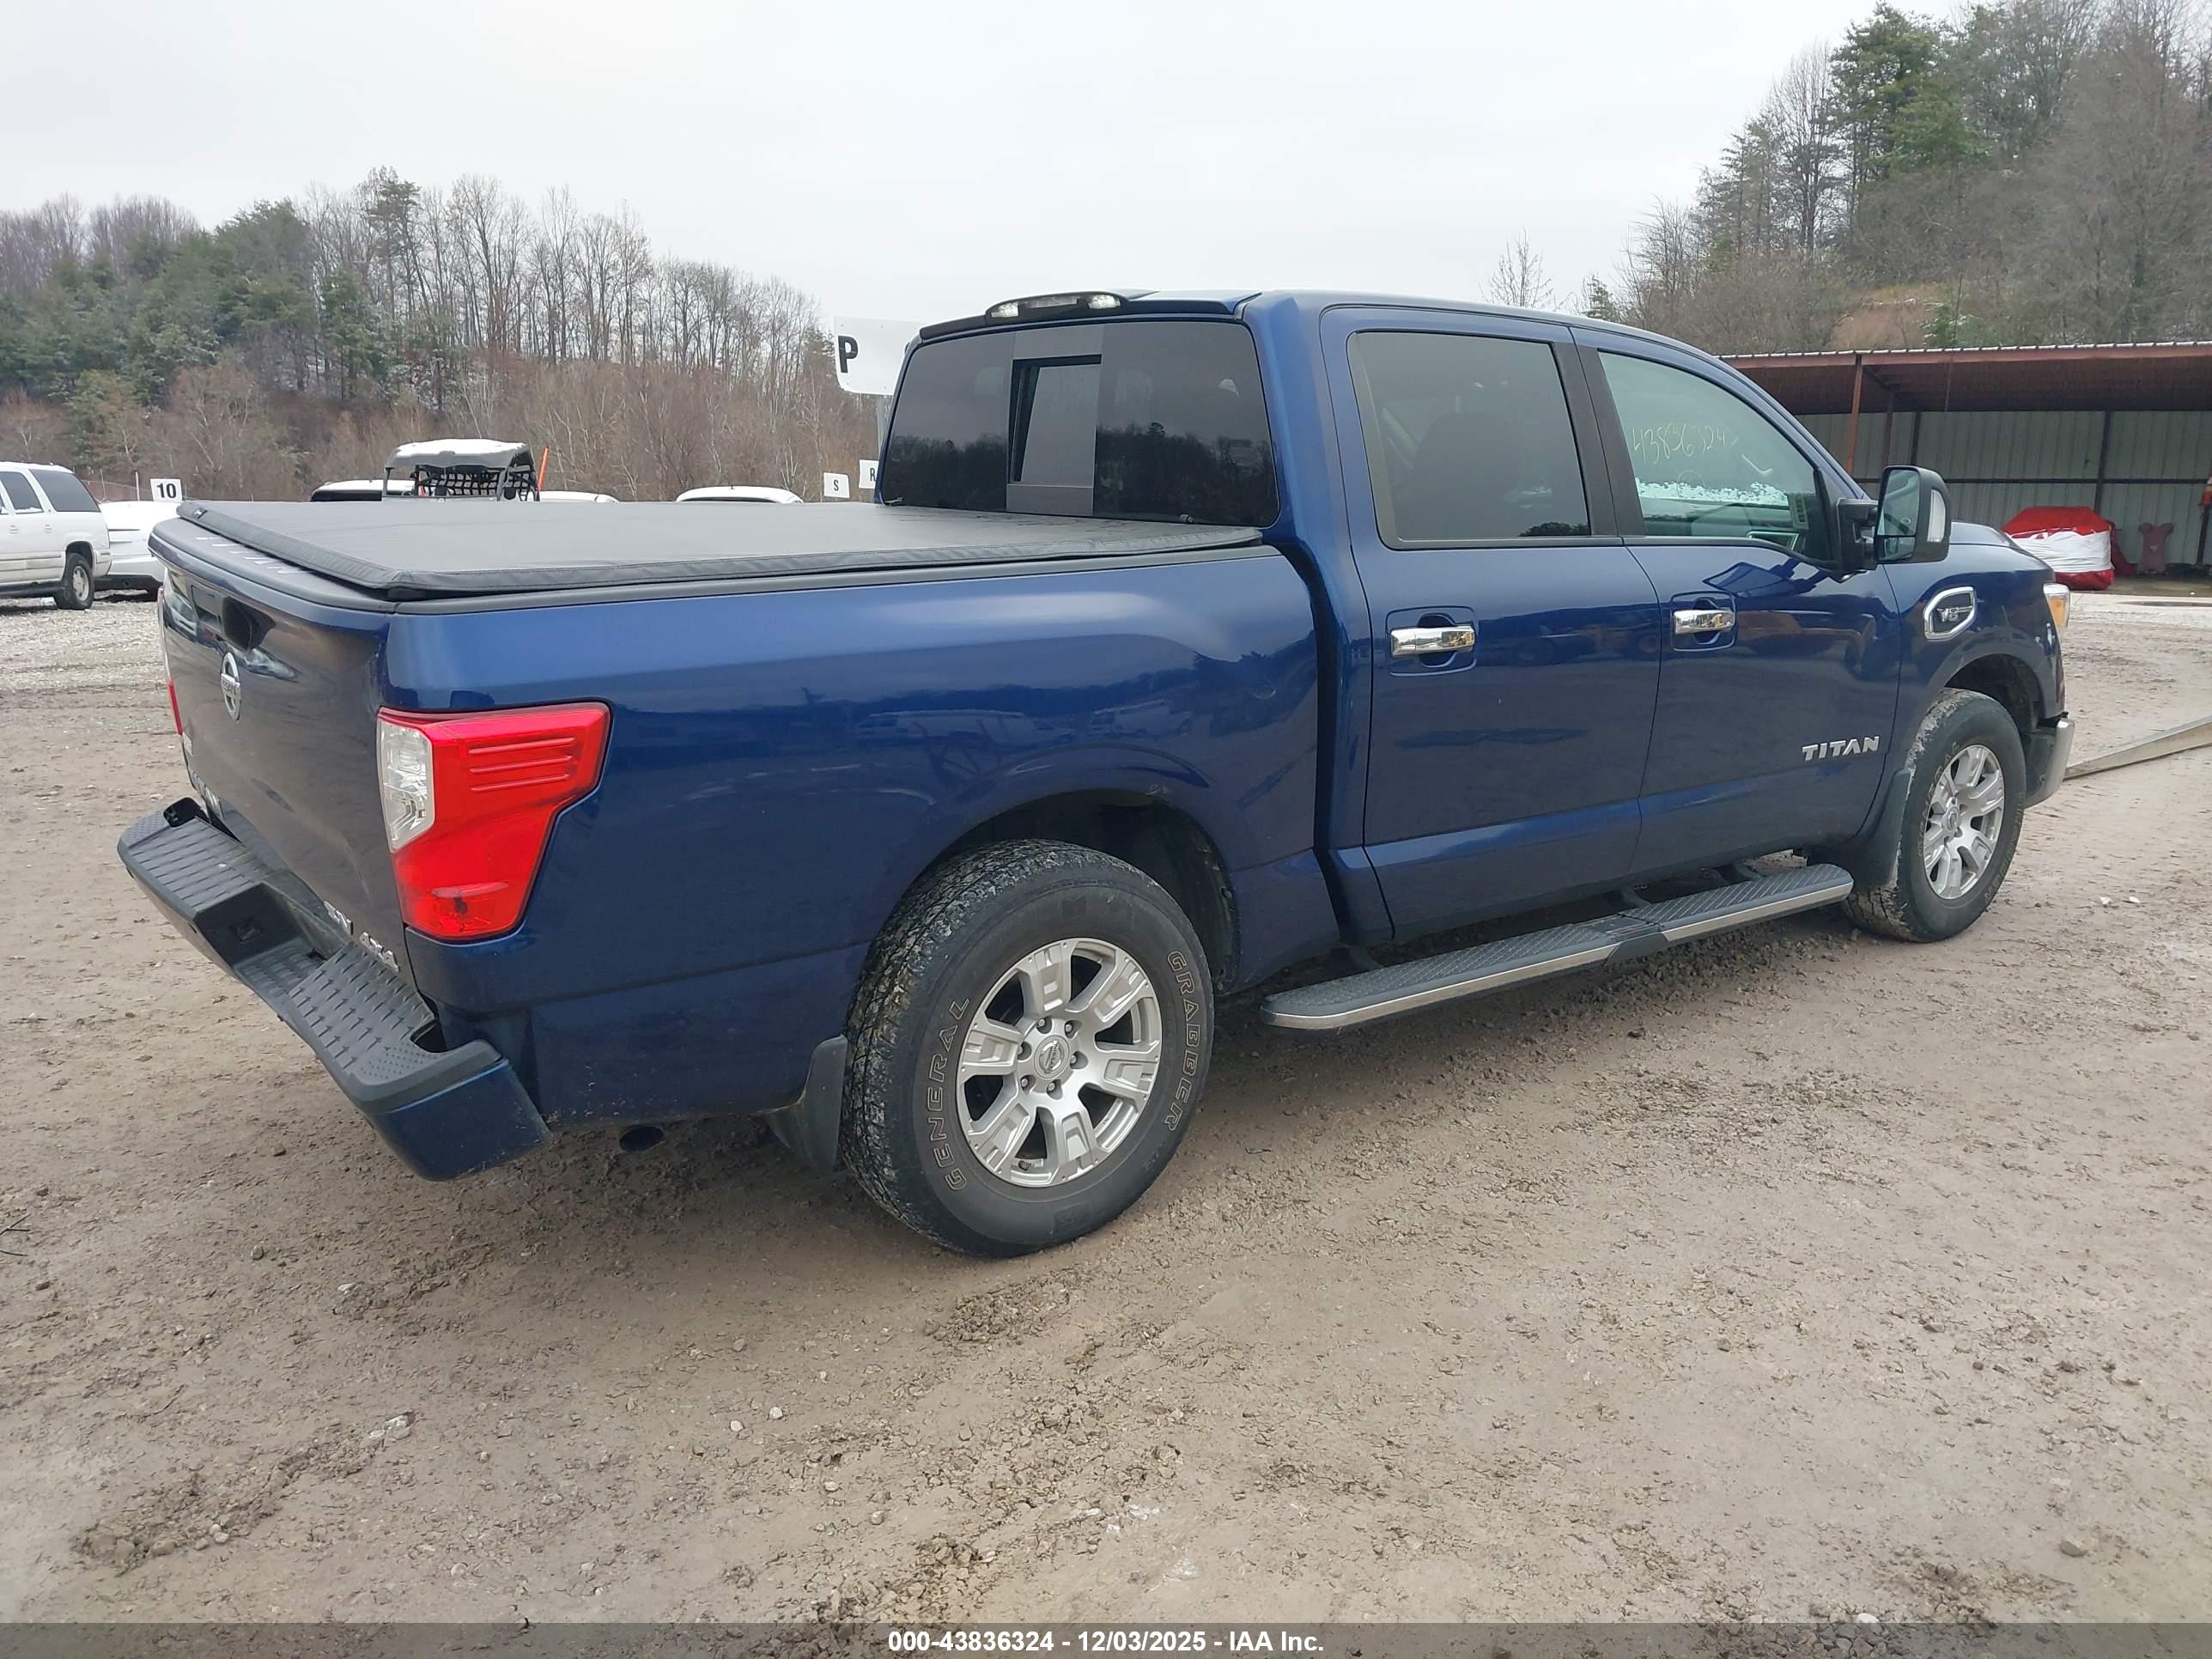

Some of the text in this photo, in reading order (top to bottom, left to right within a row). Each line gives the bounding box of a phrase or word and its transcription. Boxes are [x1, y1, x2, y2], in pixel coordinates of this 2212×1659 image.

[838, 335, 859, 374] P
[156, 483, 177, 498] 10
[833, 479, 840, 492] S
[1802, 736, 1880, 762] TITAN
[1164, 951, 1200, 1132] GRABBER
[926, 998, 970, 1191] GENERAL
